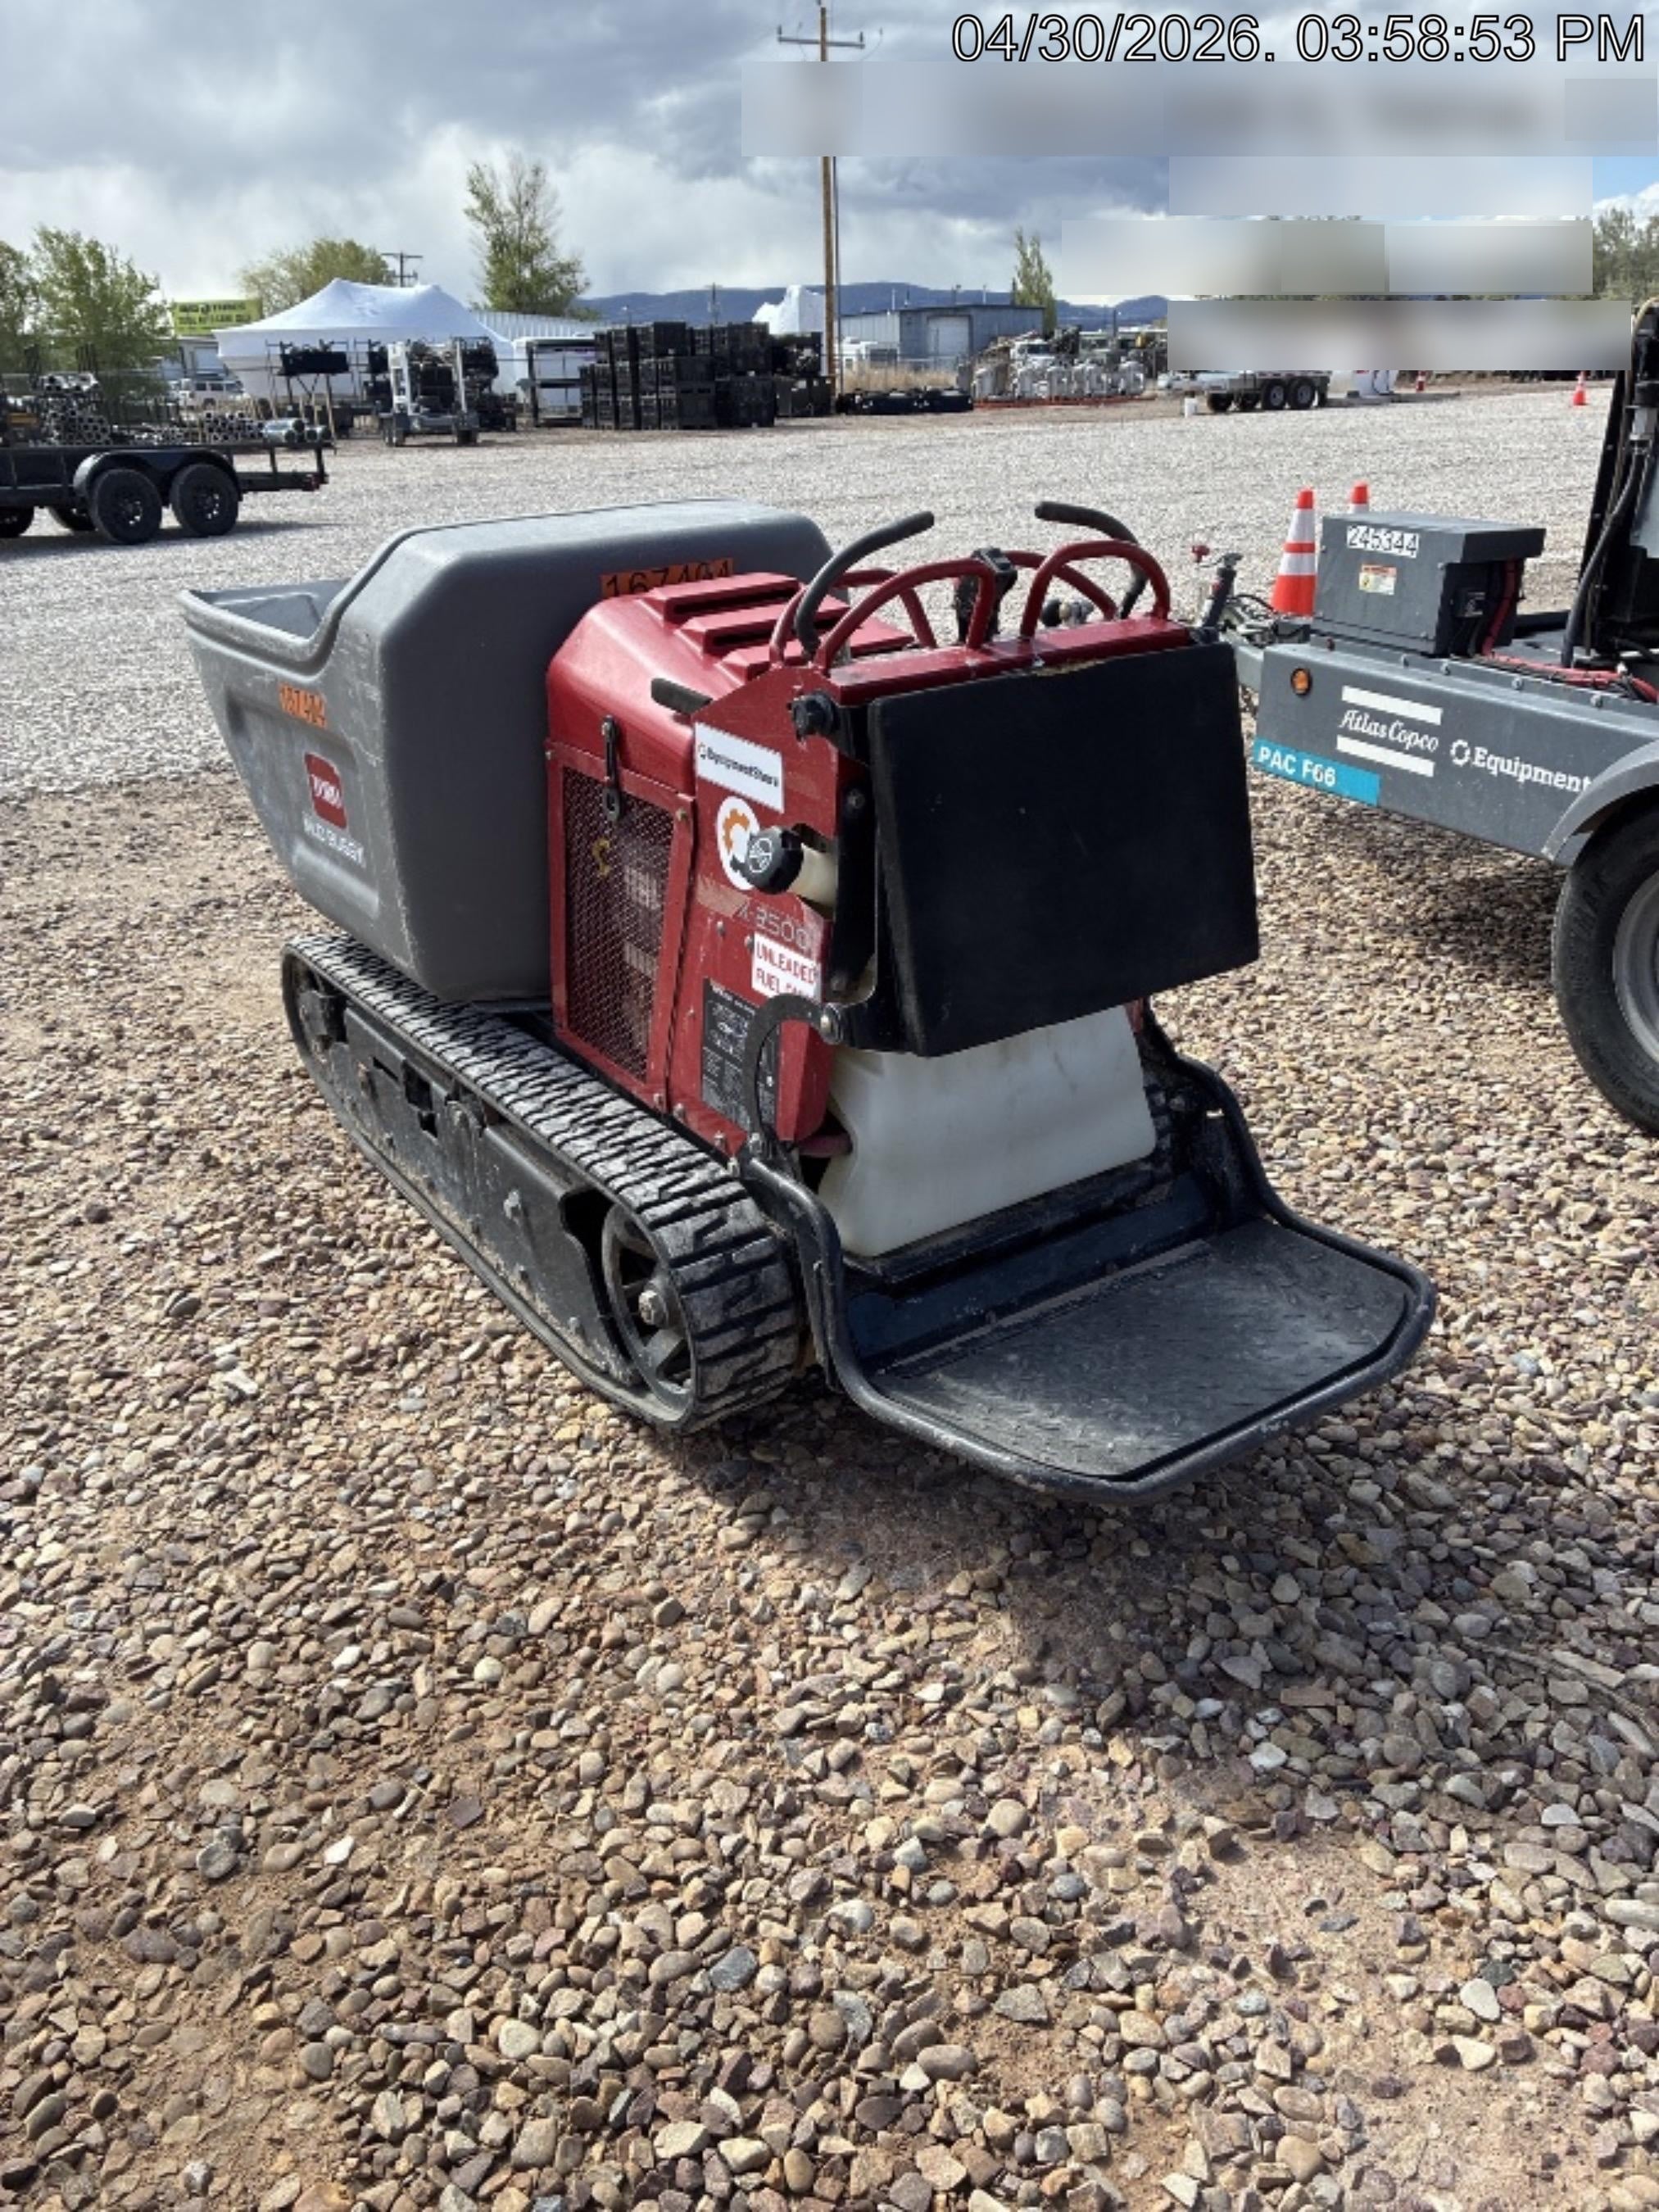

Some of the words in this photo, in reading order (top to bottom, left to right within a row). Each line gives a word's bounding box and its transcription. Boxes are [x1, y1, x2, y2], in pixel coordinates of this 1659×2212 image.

[1348, 524, 1417, 556] 245344
[1337, 709, 1387, 737] Atlas
[1389, 720, 1439, 752] Copco
[1258, 746, 1296, 775] PAC
[756, 968, 781, 994] FUEL
